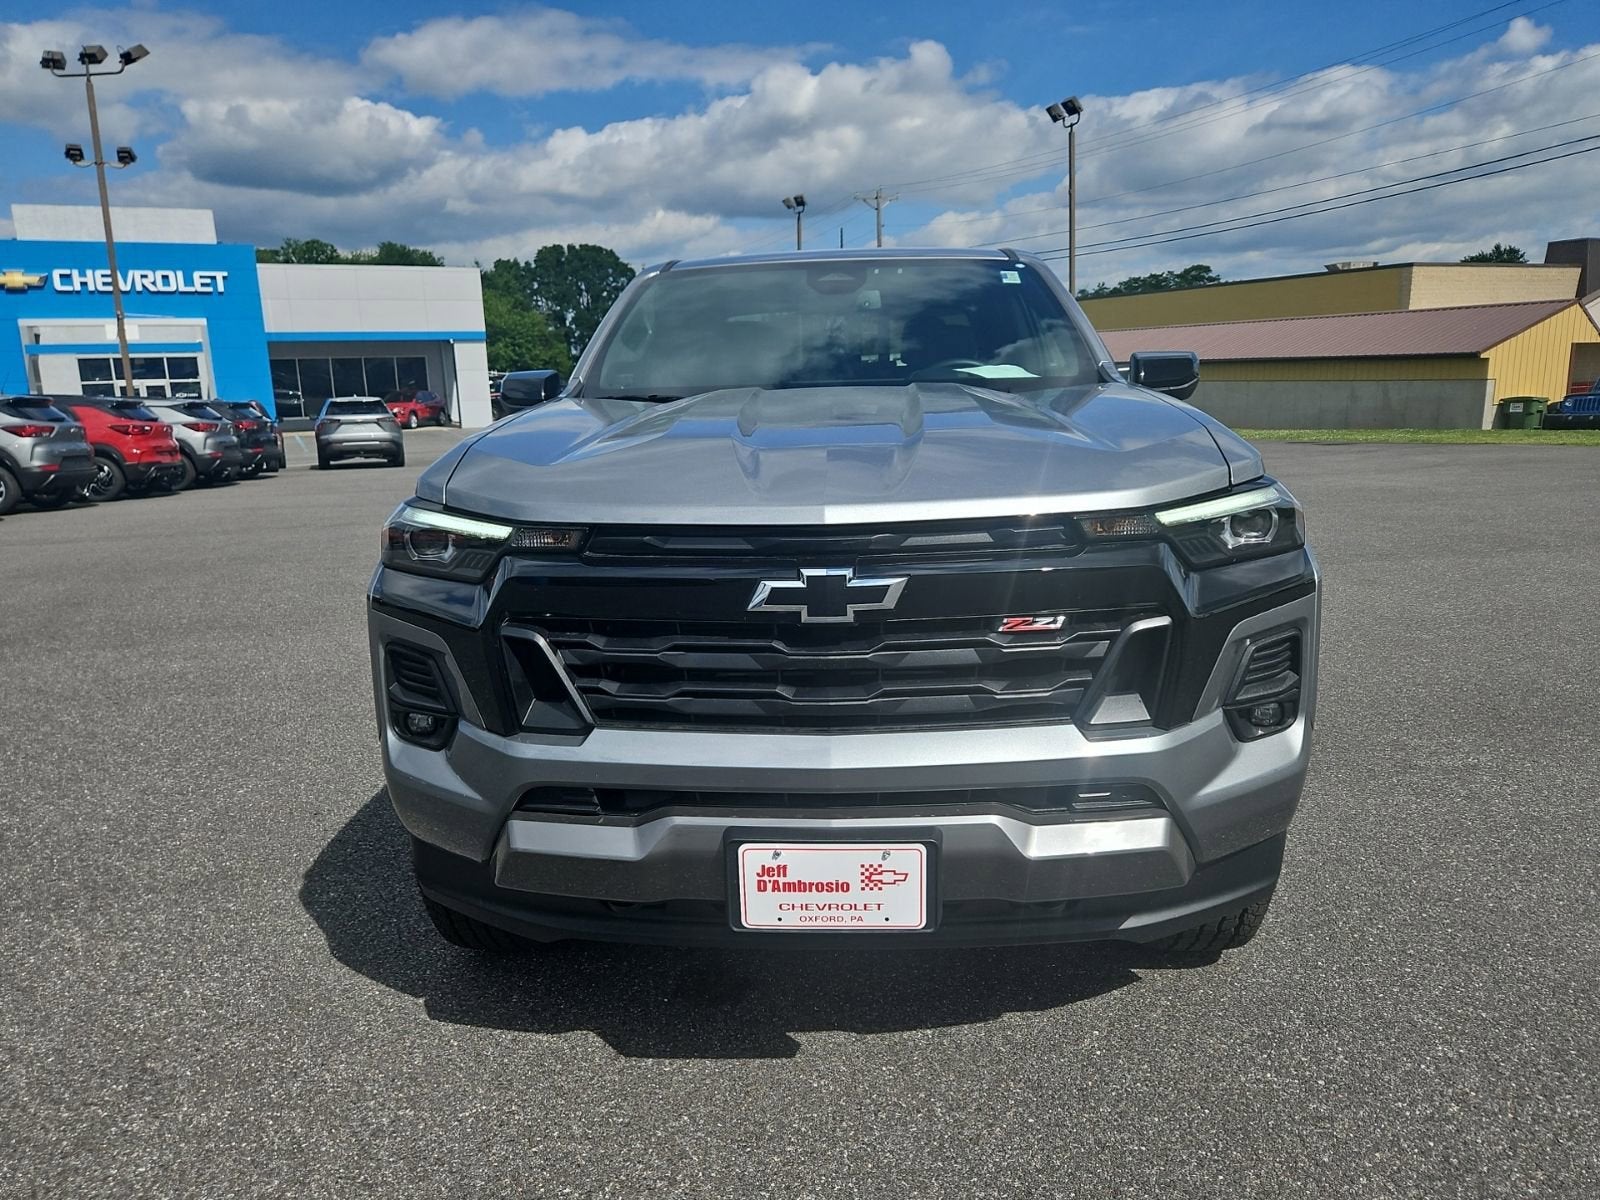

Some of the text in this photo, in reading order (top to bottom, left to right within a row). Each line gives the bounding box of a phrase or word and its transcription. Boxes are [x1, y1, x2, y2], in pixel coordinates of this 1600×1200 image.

[52, 268, 229, 293] CHEVROLET
[998, 615, 1066, 632] Z71
[756, 864, 788, 878] Jeff
[757, 879, 851, 893] D'Ambrosio
[778, 903, 885, 912] CHEVROLET
[799, 915, 864, 924] OXFORD, PA
